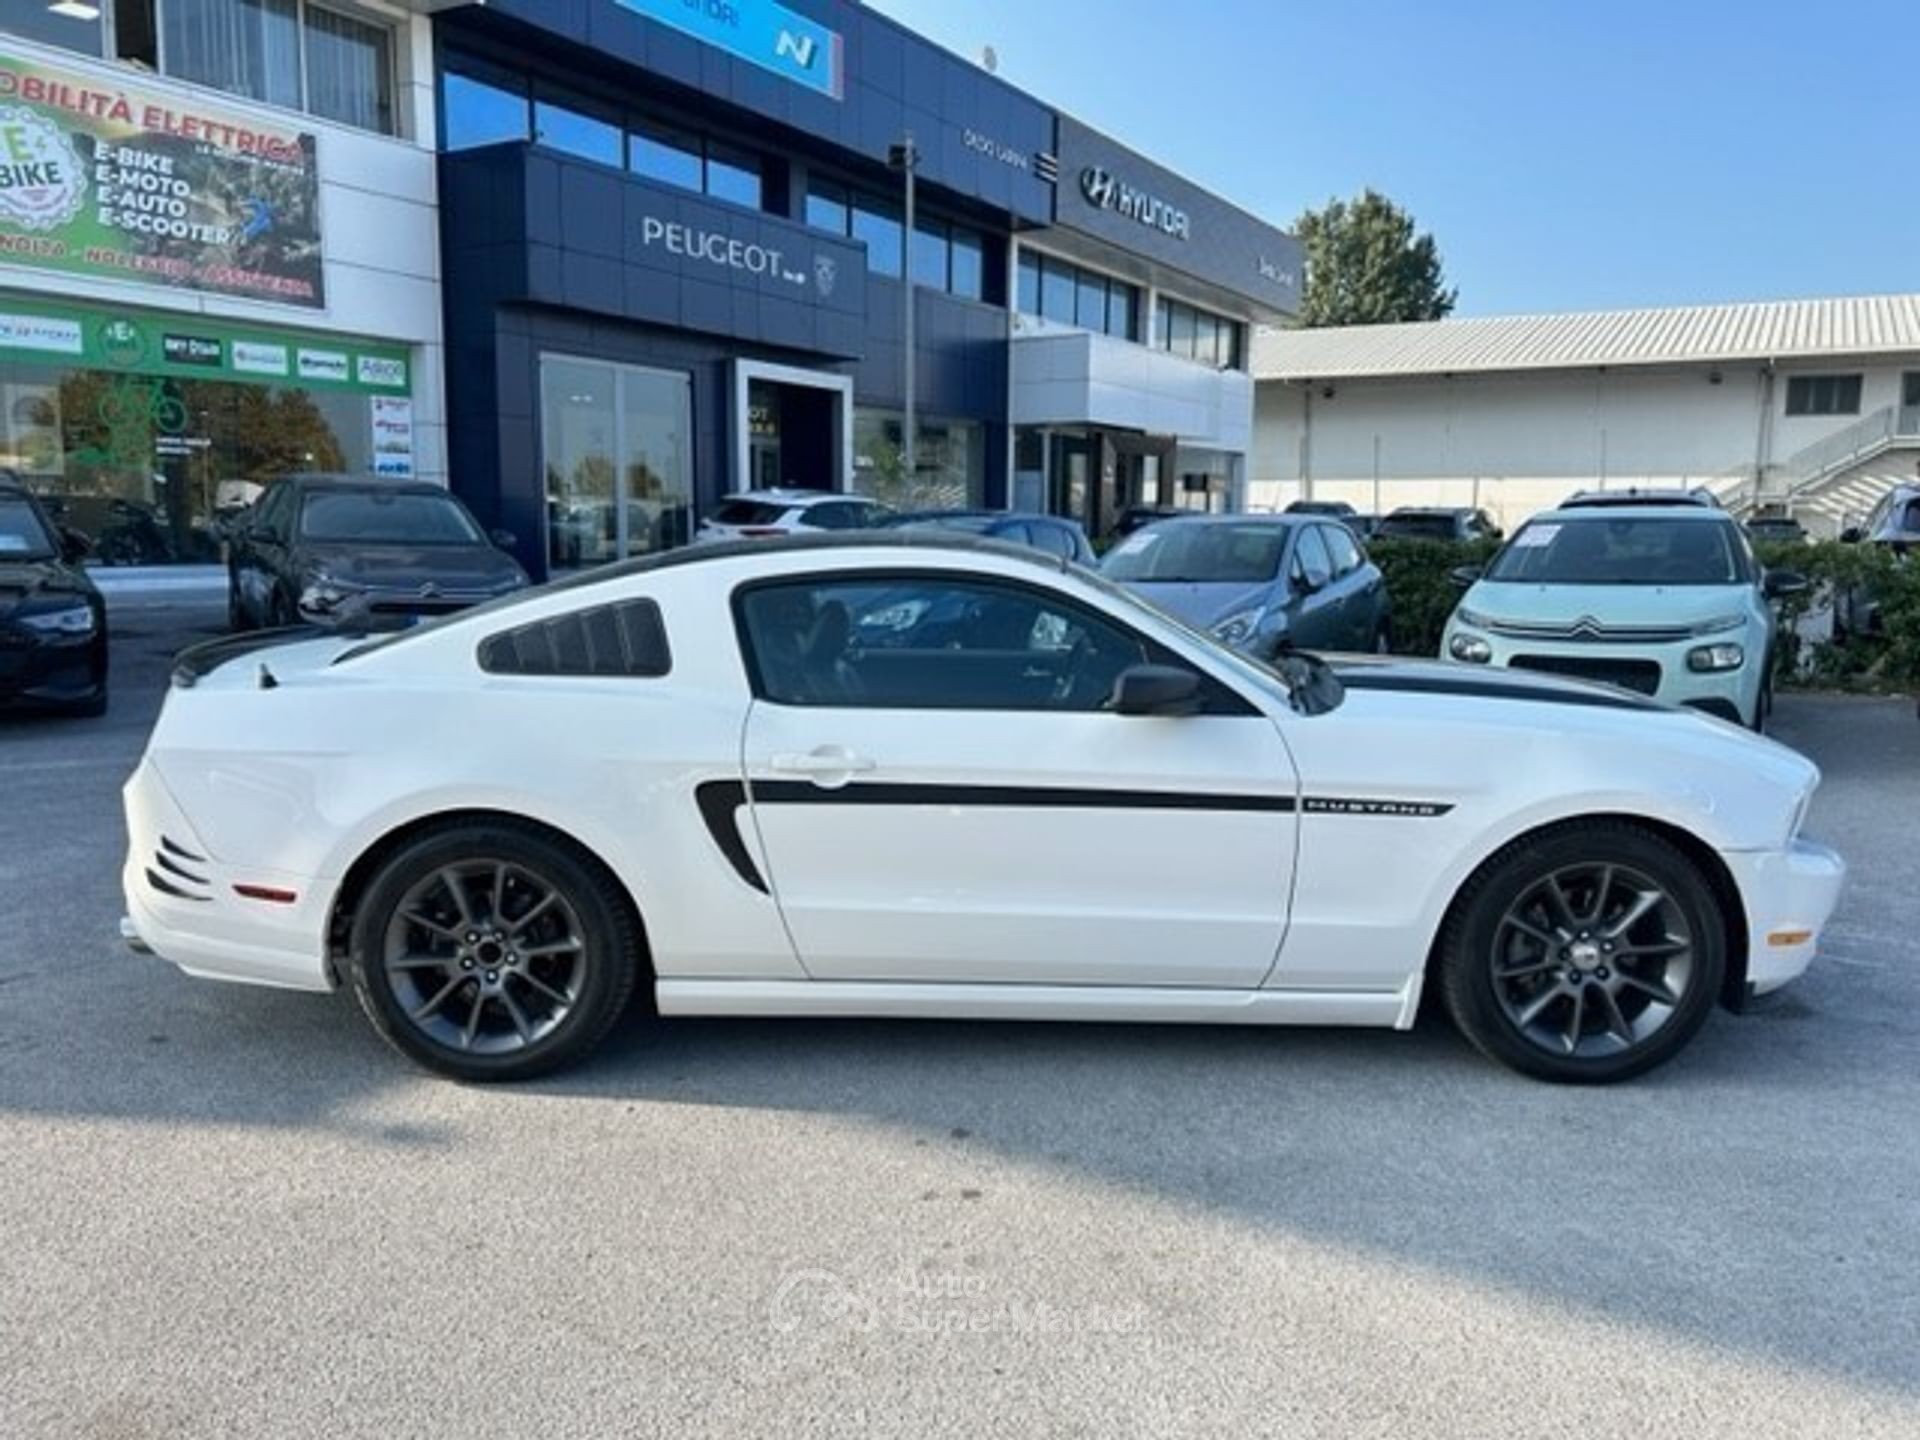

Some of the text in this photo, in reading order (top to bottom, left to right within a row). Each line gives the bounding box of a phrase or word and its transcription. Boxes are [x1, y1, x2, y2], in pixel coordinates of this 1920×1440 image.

[0, 71, 133, 124] OBILITÀ
[0, 161, 63, 188] BIKE
[94, 140, 174, 175] E-BIKE
[96, 164, 190, 198] E-MOTO
[96, 185, 187, 218] E-AUTO
[97, 207, 230, 246] E-SCOOTER
[642, 215, 784, 277] PEUGEOT
